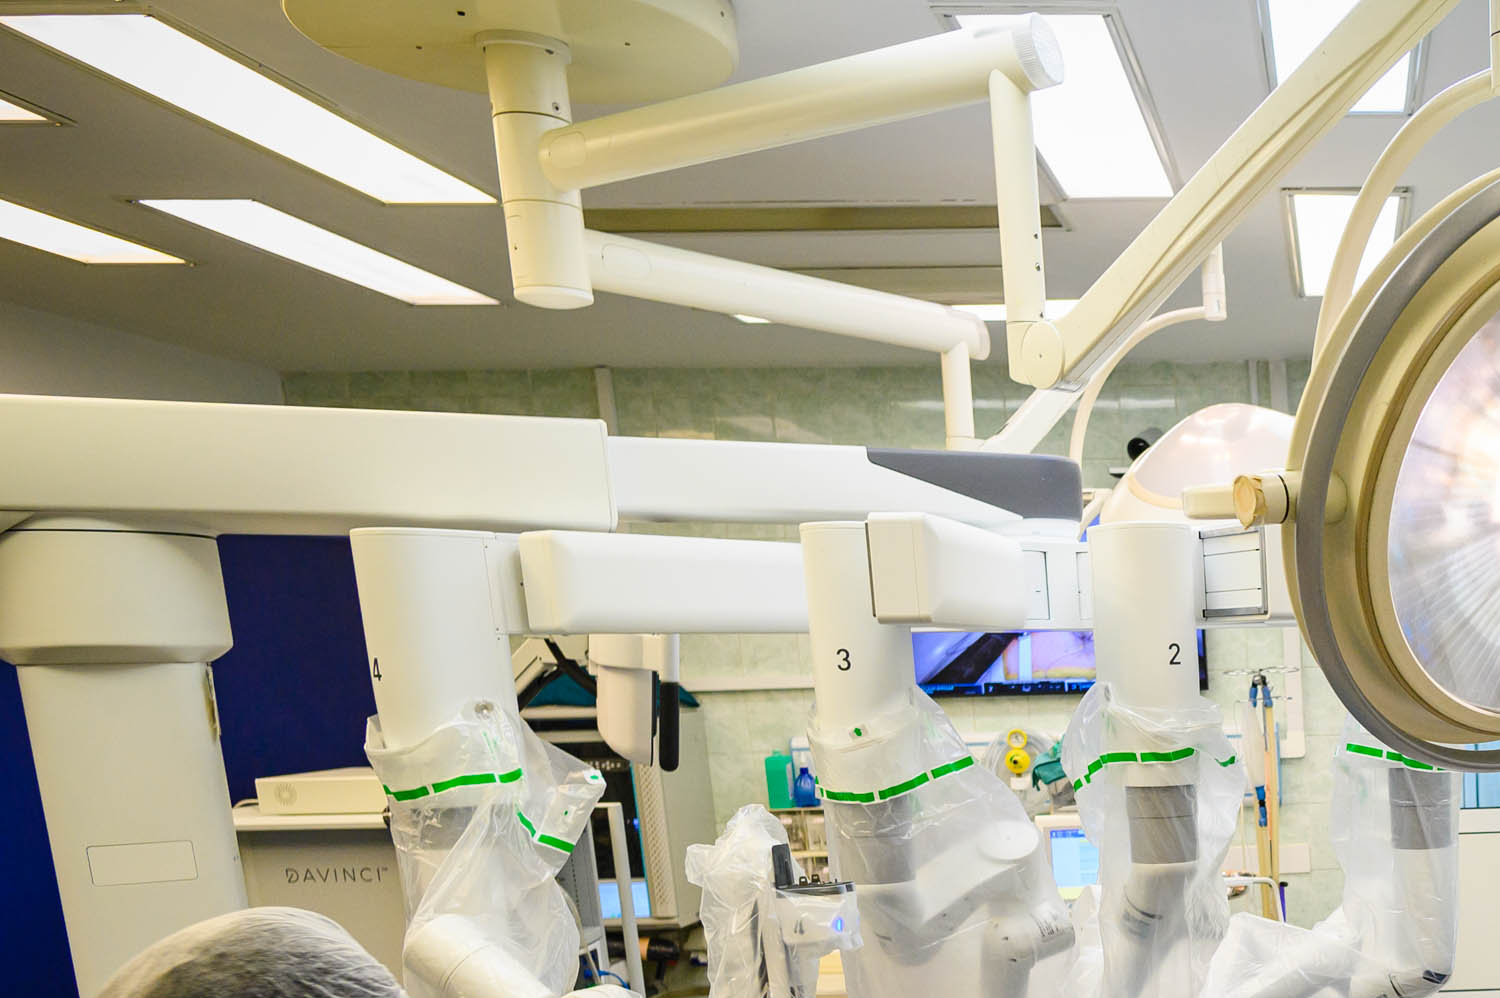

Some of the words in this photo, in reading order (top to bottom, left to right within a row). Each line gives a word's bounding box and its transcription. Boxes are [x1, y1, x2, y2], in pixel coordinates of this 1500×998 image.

[836, 648, 851, 671] 3
[1168, 643, 1181, 665] 2
[372, 657, 382, 681] 4
